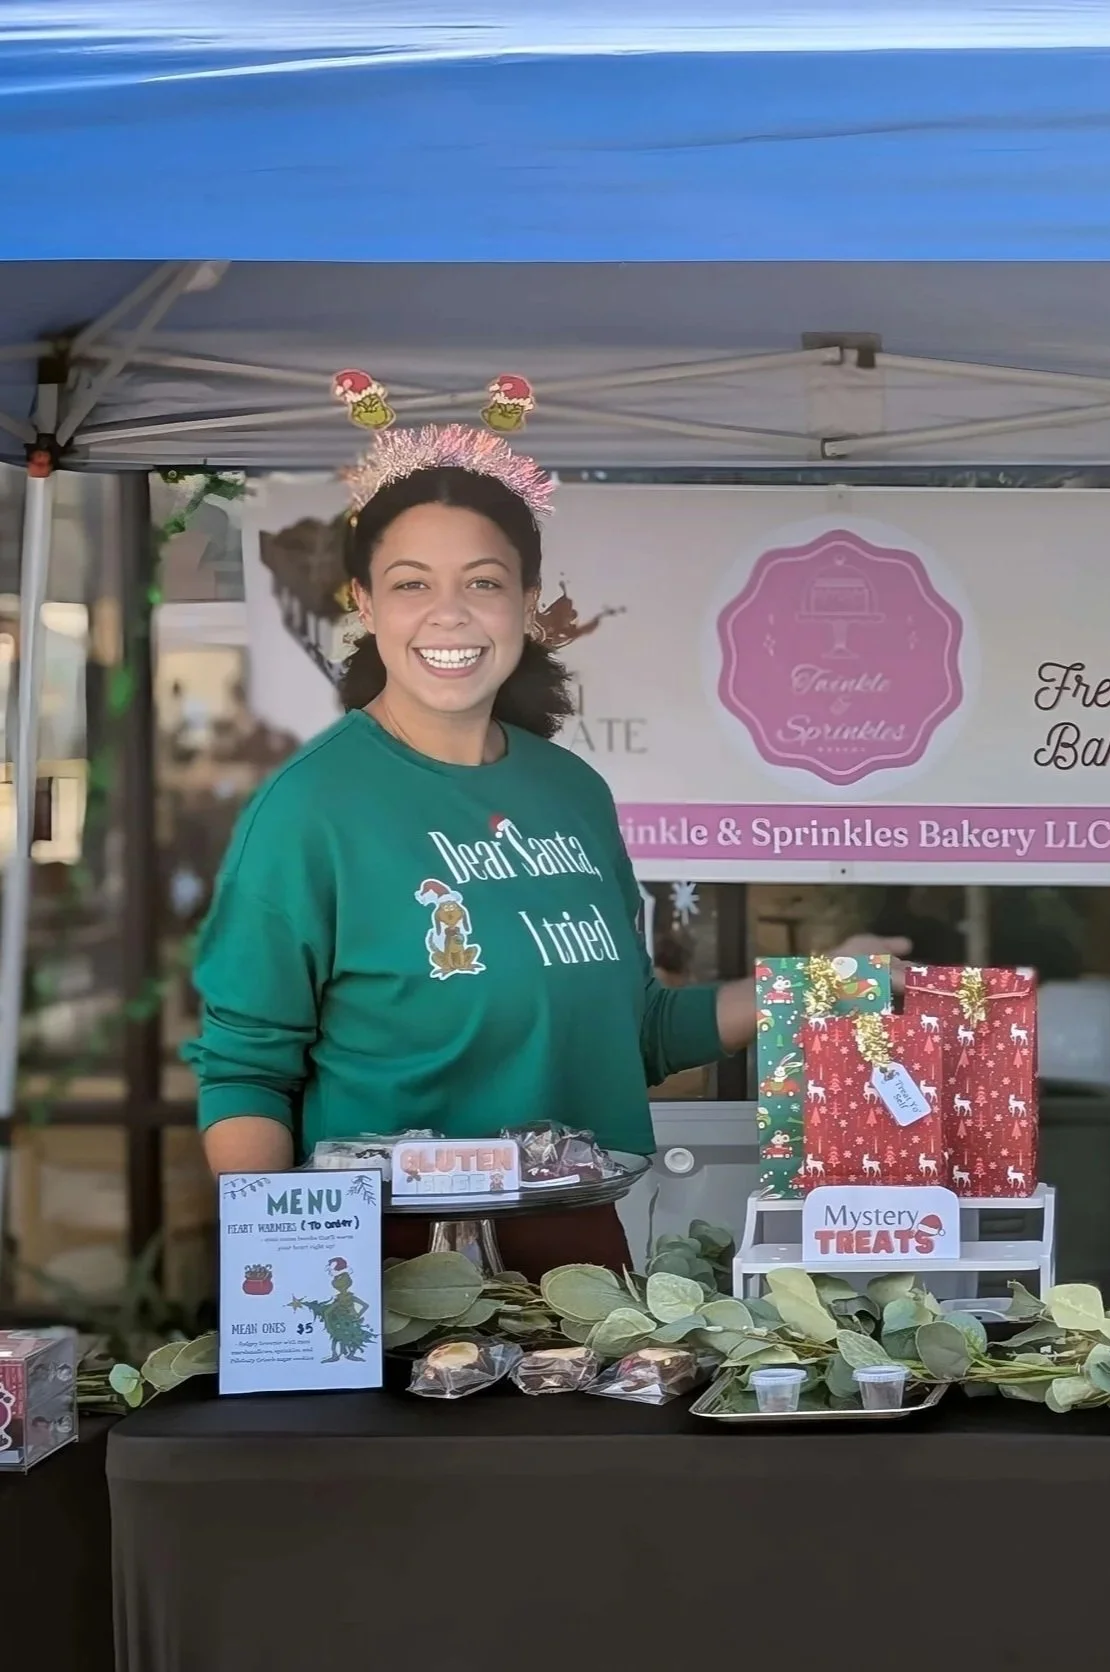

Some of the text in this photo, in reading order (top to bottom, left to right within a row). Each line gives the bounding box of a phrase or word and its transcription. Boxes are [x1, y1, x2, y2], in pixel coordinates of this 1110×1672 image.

[790, 663, 890, 695] Twinkle
[776, 714, 906, 748] Sprinkles
[620, 817, 708, 846] inkle
[717, 817, 742, 846] &
[751, 818, 909, 854] Sprinkles
[919, 820, 1036, 856] Bakery
[427, 822, 604, 884] Dear Santa,
[518, 903, 620, 966] I tried
[893, 1093, 909, 1109] Self
[400, 1147, 512, 1173] GLUTEN
[415, 1174, 485, 1194] FREE
[267, 1188, 342, 1216] MENU
[227, 1223, 253, 1235] HEART
[258, 1222, 297, 1234] WARMERS
[824, 1205, 919, 1232] Mystery
[815, 1229, 935, 1255] TREATS
[231, 1322, 314, 1335] MEAN ONES $5
